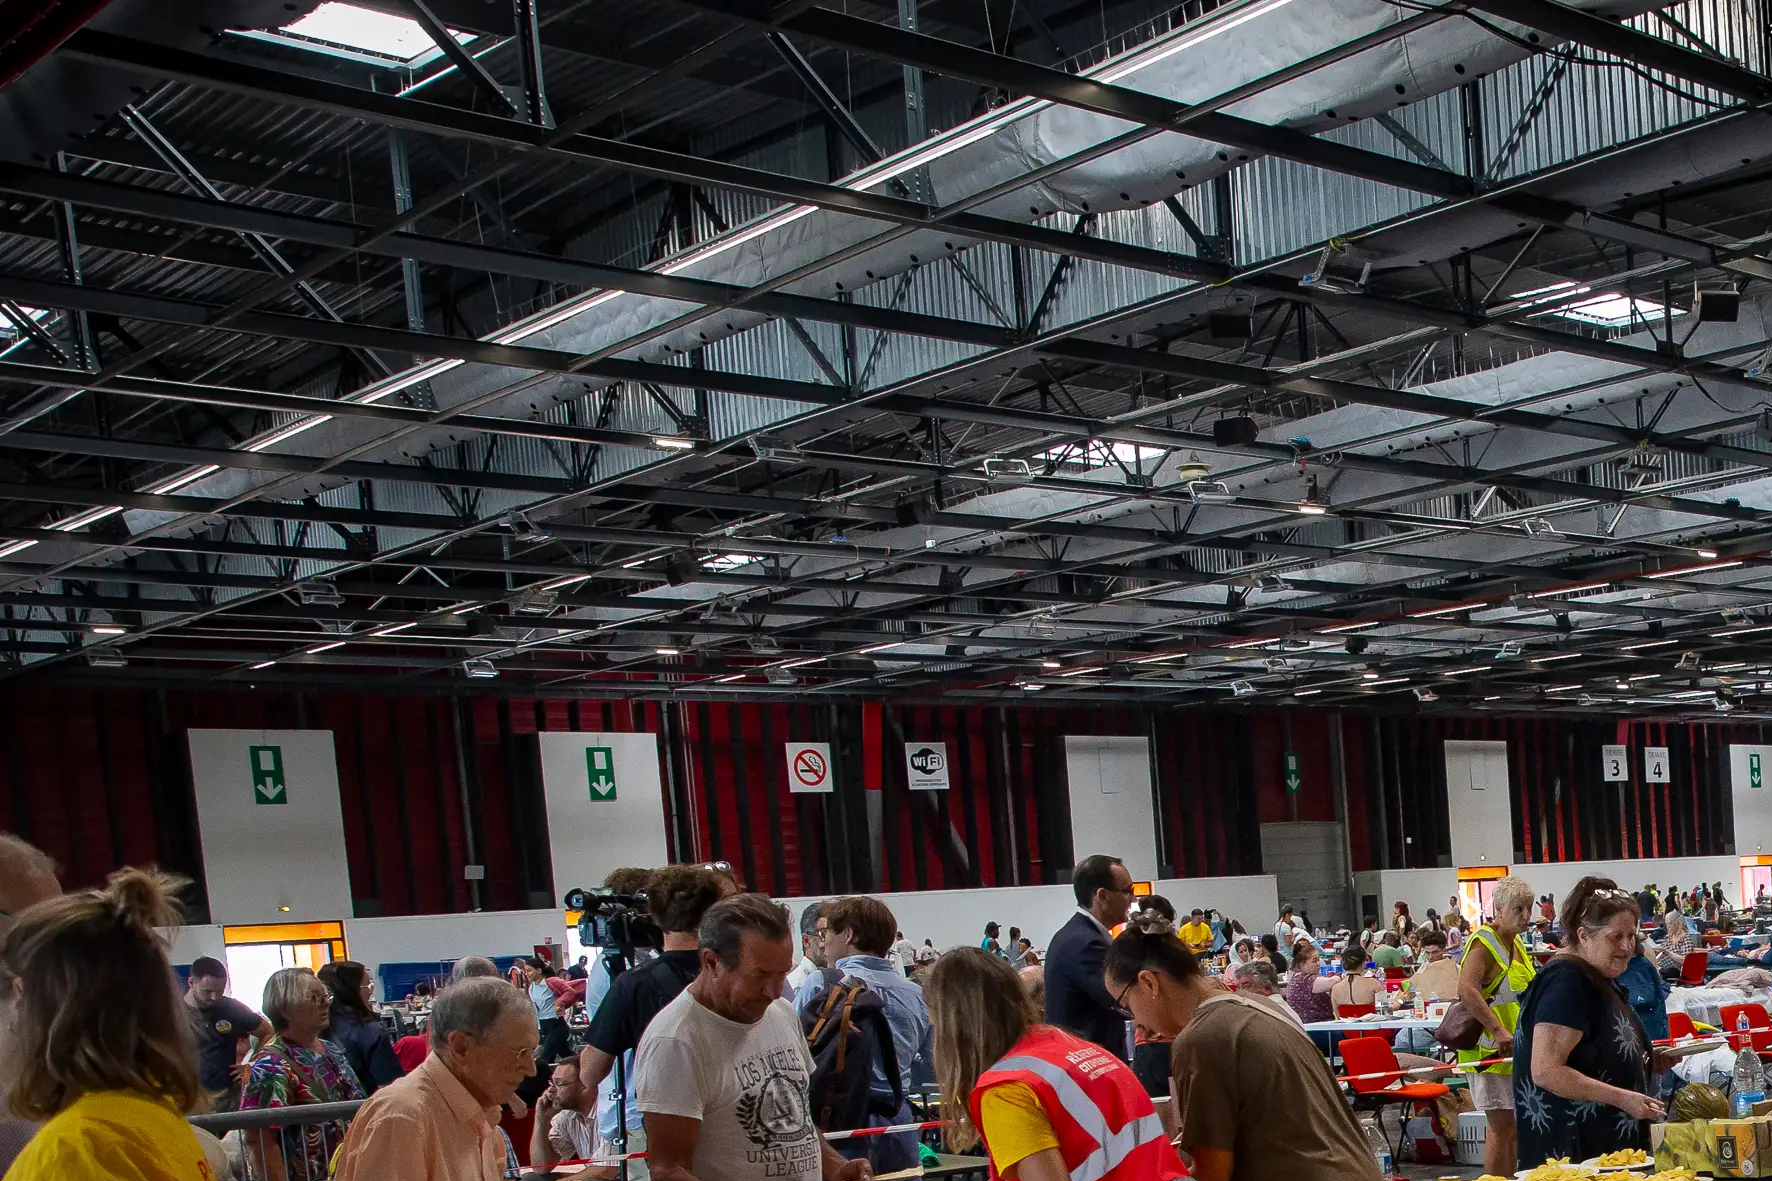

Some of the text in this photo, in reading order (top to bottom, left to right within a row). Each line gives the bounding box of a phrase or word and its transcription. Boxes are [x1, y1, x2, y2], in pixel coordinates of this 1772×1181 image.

[1611, 759, 1620, 777] 3
[1653, 761, 1662, 778] 4
[734, 1061, 762, 1091] LOS
[764, 1155, 818, 1178] LEAGUE
